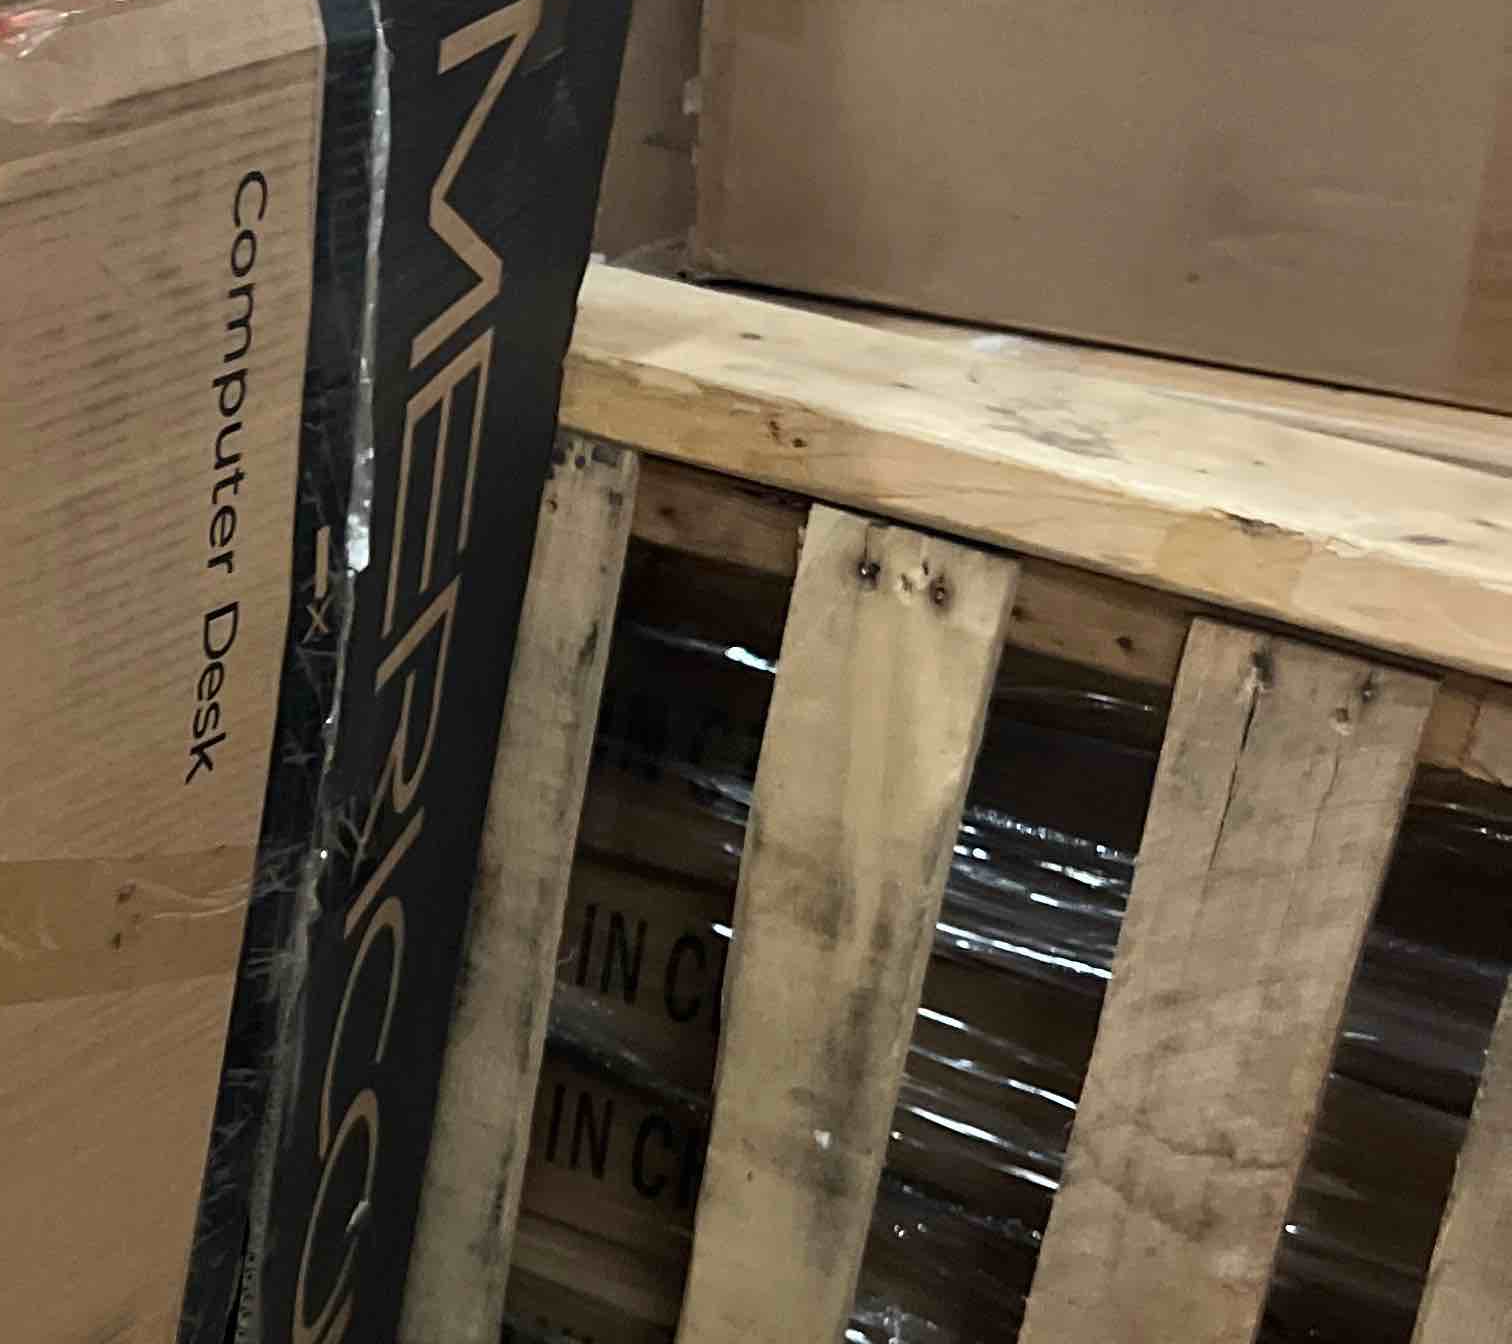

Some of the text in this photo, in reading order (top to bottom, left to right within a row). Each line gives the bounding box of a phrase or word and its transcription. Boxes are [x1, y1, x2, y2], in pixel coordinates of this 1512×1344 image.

[184, 169, 270, 786] Computer Desk
[575, 903, 649, 1005] IN
[544, 1083, 616, 1180] IN
